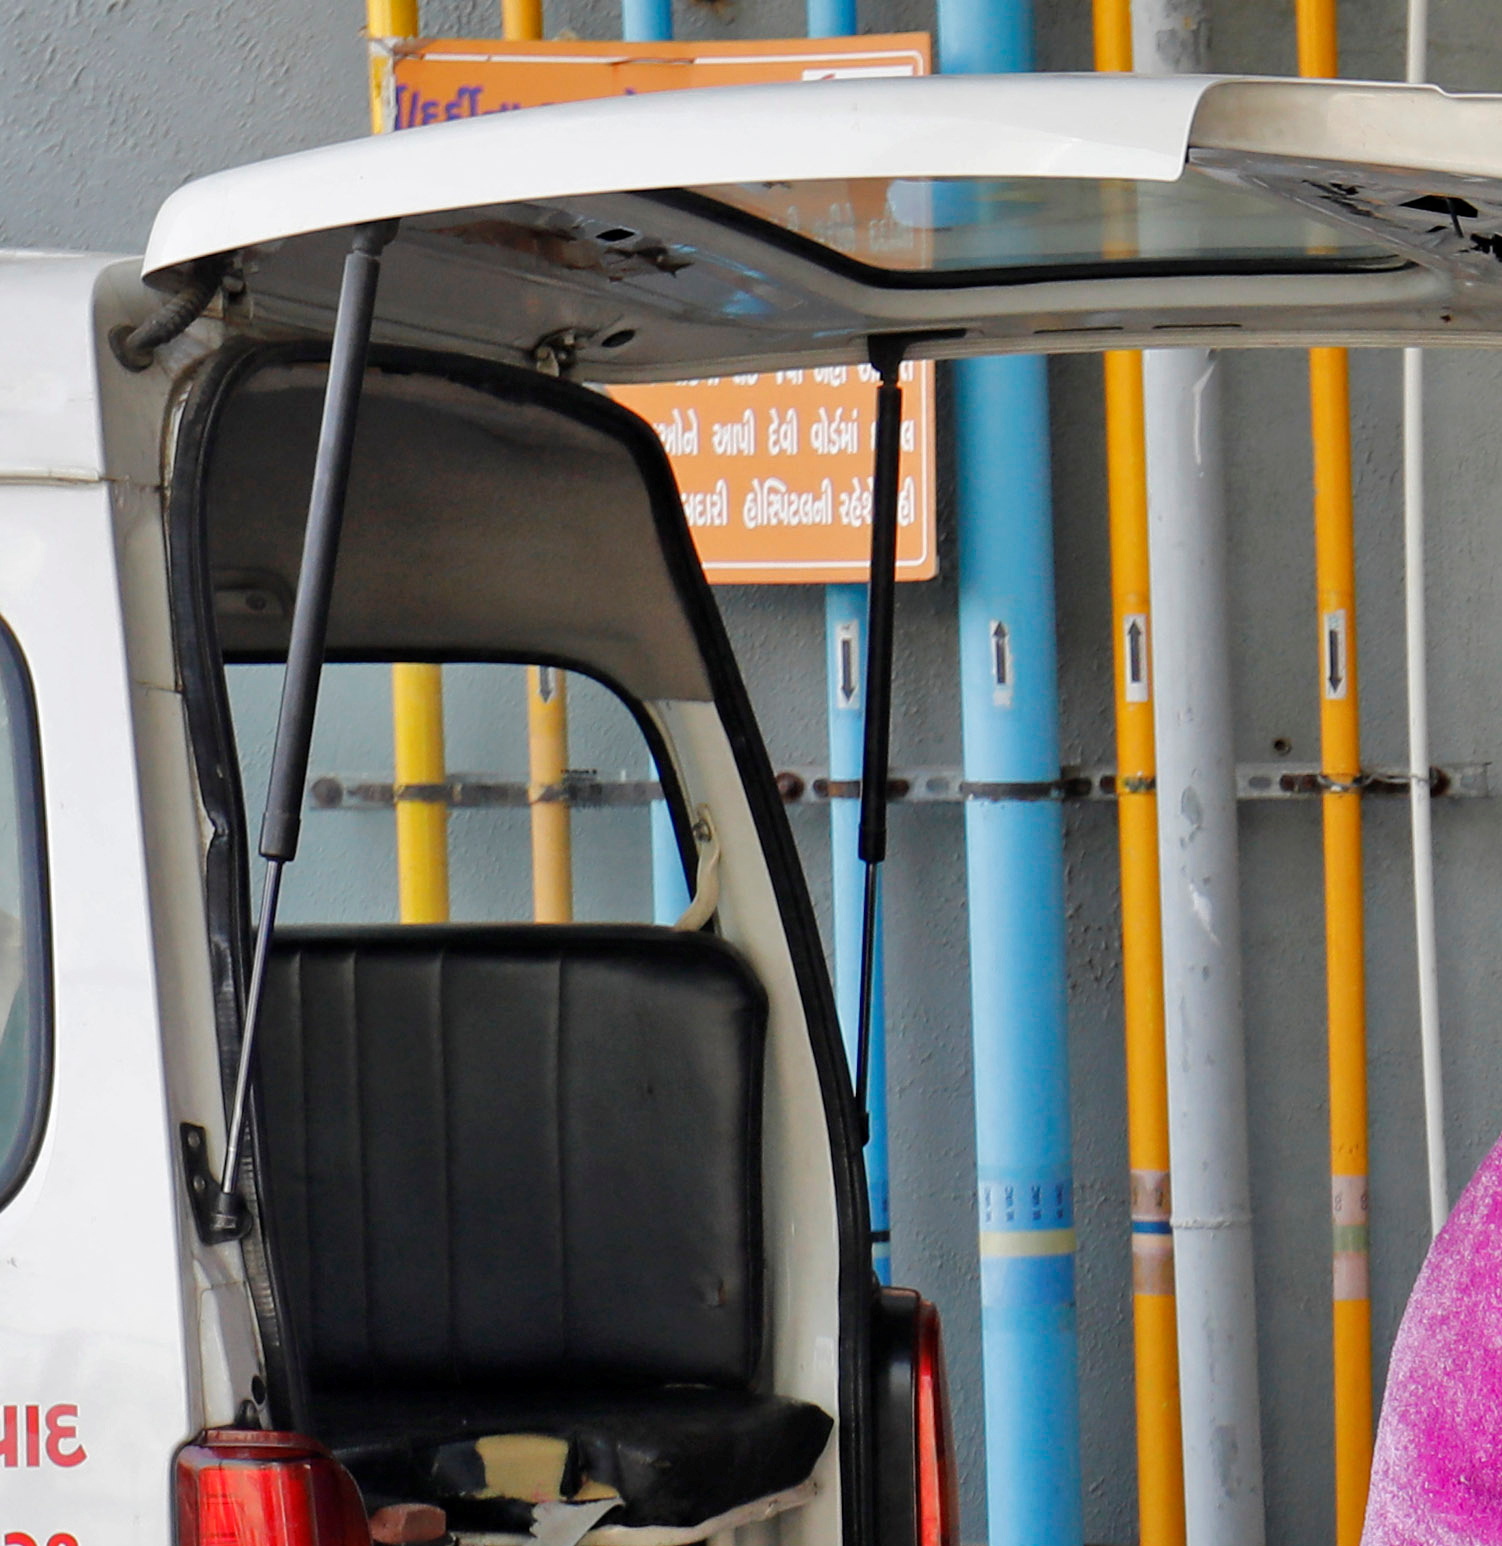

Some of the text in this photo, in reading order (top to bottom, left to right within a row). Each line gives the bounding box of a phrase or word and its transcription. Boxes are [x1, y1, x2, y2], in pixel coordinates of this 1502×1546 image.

[653, 408, 699, 456] ઓને
[711, 407, 755, 456] આપી
[768, 407, 798, 456] દેવી
[810, 407, 858, 456] વોર્ડમાં
[681, 478, 729, 527] બદારી
[743, 477, 832, 530] હોસ્પિટલની
